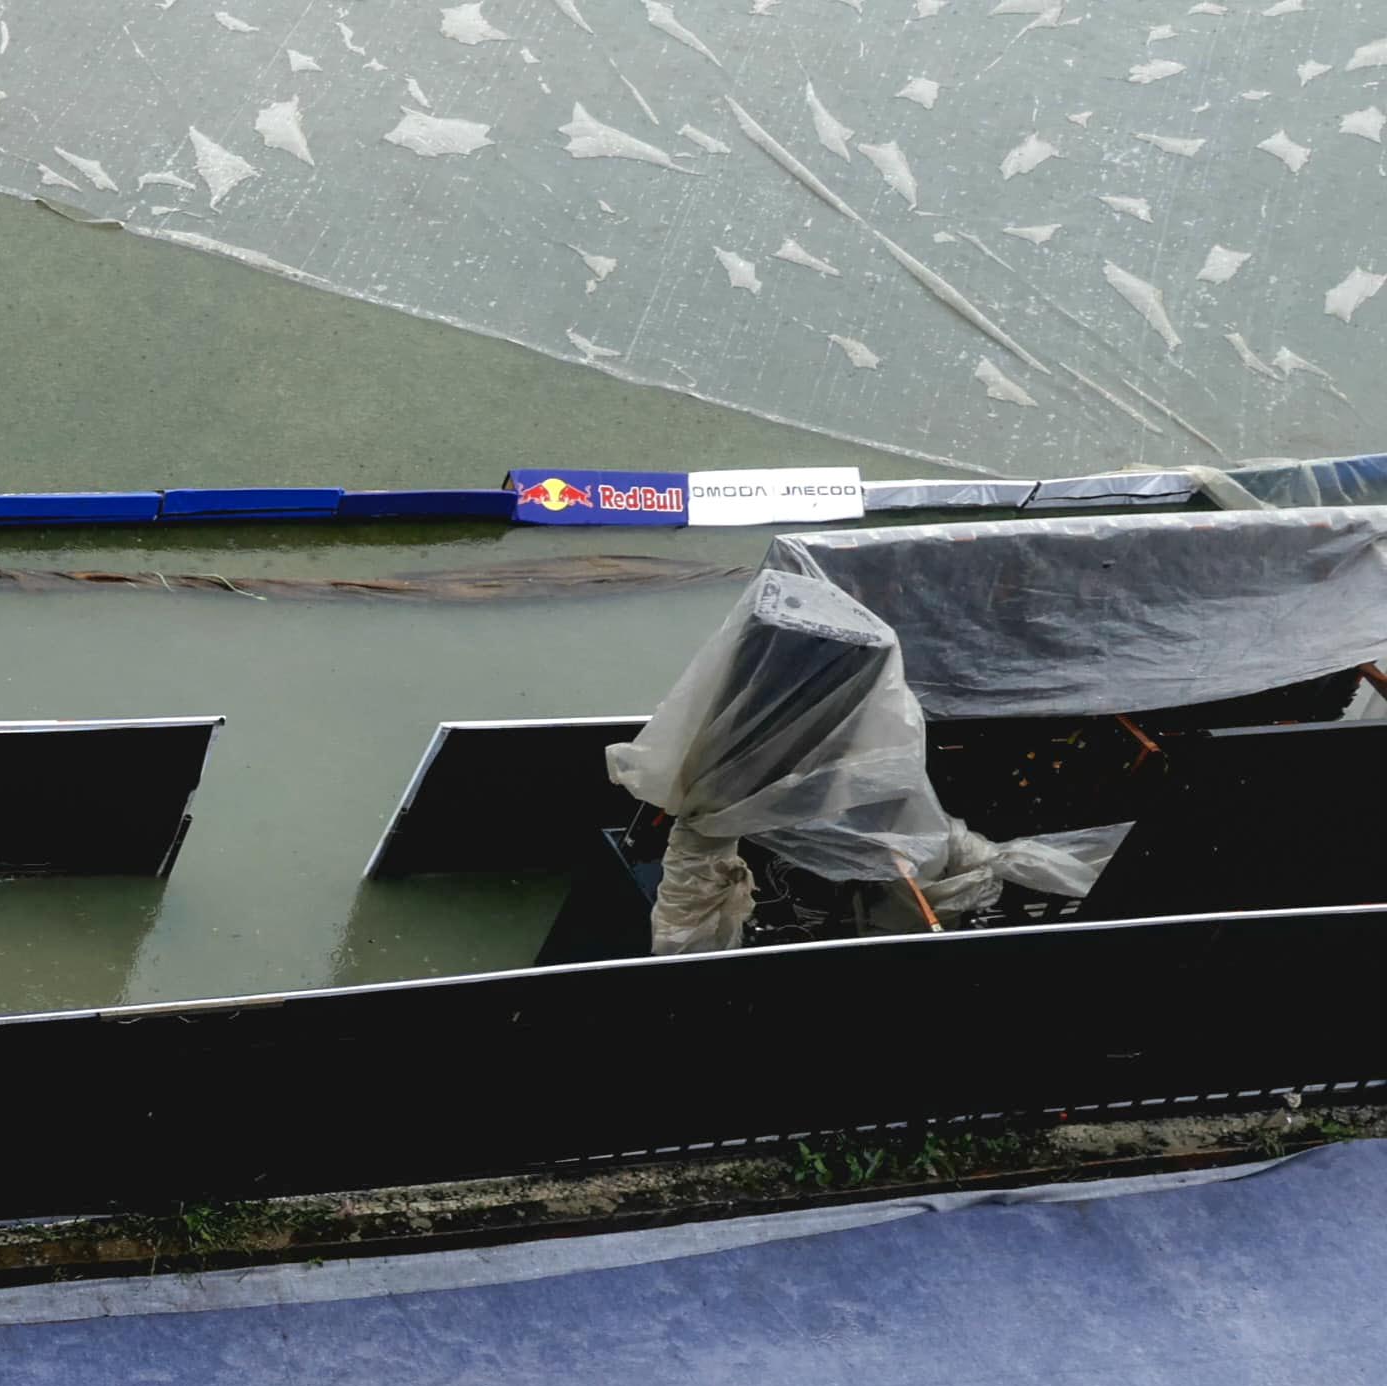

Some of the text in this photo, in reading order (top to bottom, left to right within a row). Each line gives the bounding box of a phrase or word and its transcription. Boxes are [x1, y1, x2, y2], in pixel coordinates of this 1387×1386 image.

[598, 484, 683, 512] Red Bull
[692, 485, 857, 497] OMODA JAECOO
